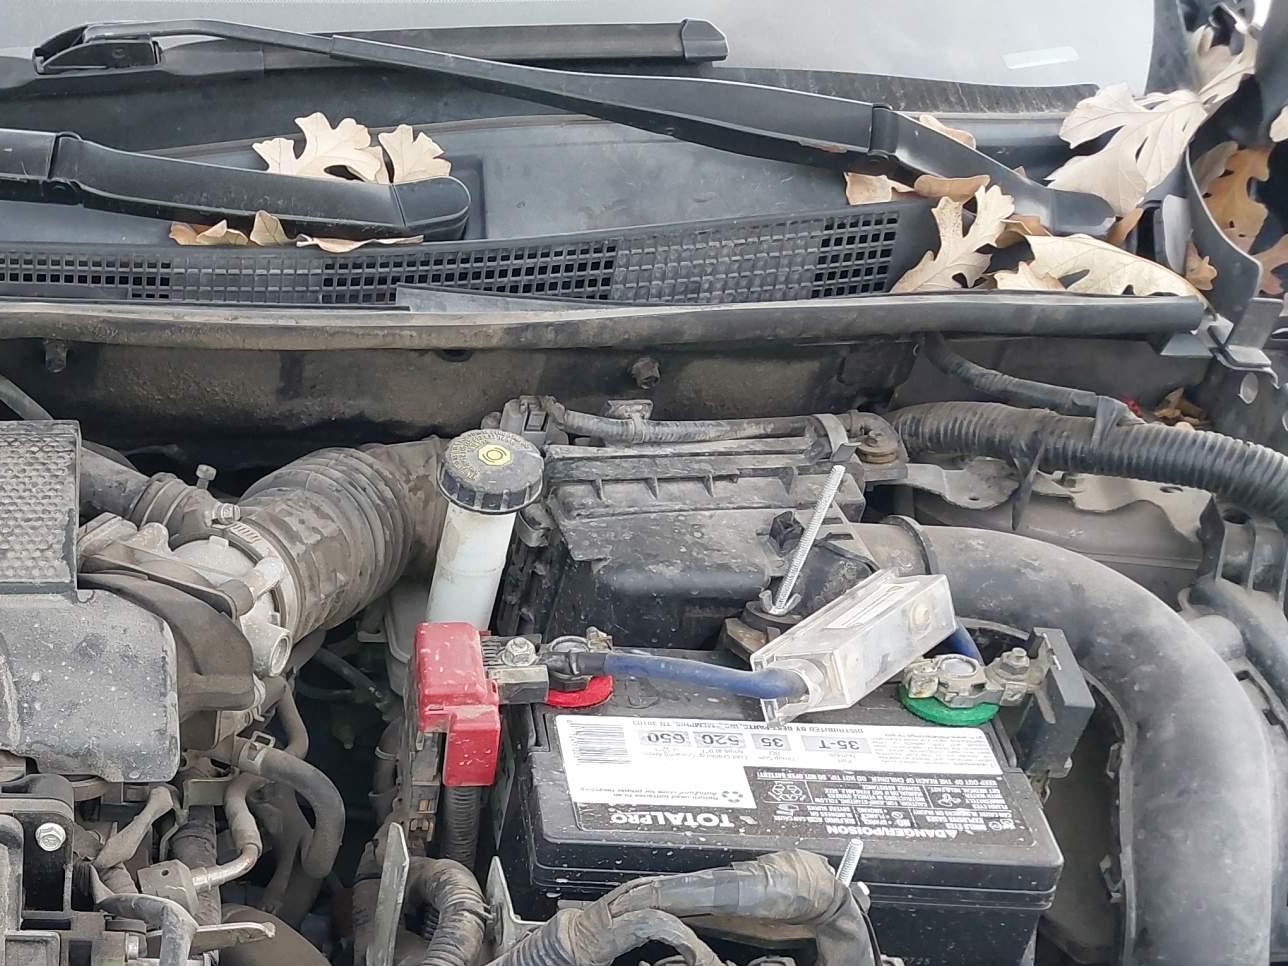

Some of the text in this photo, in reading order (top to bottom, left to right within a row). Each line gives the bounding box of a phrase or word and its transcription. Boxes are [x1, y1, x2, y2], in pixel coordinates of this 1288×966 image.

[648, 733, 685, 744] 650
[701, 734, 740, 746] 520
[760, 737, 784, 748] 35
[818, 739, 860, 750] 35-T
[610, 810, 736, 828] TOTALPRO
[827, 825, 947, 839] DANGER/POISON
